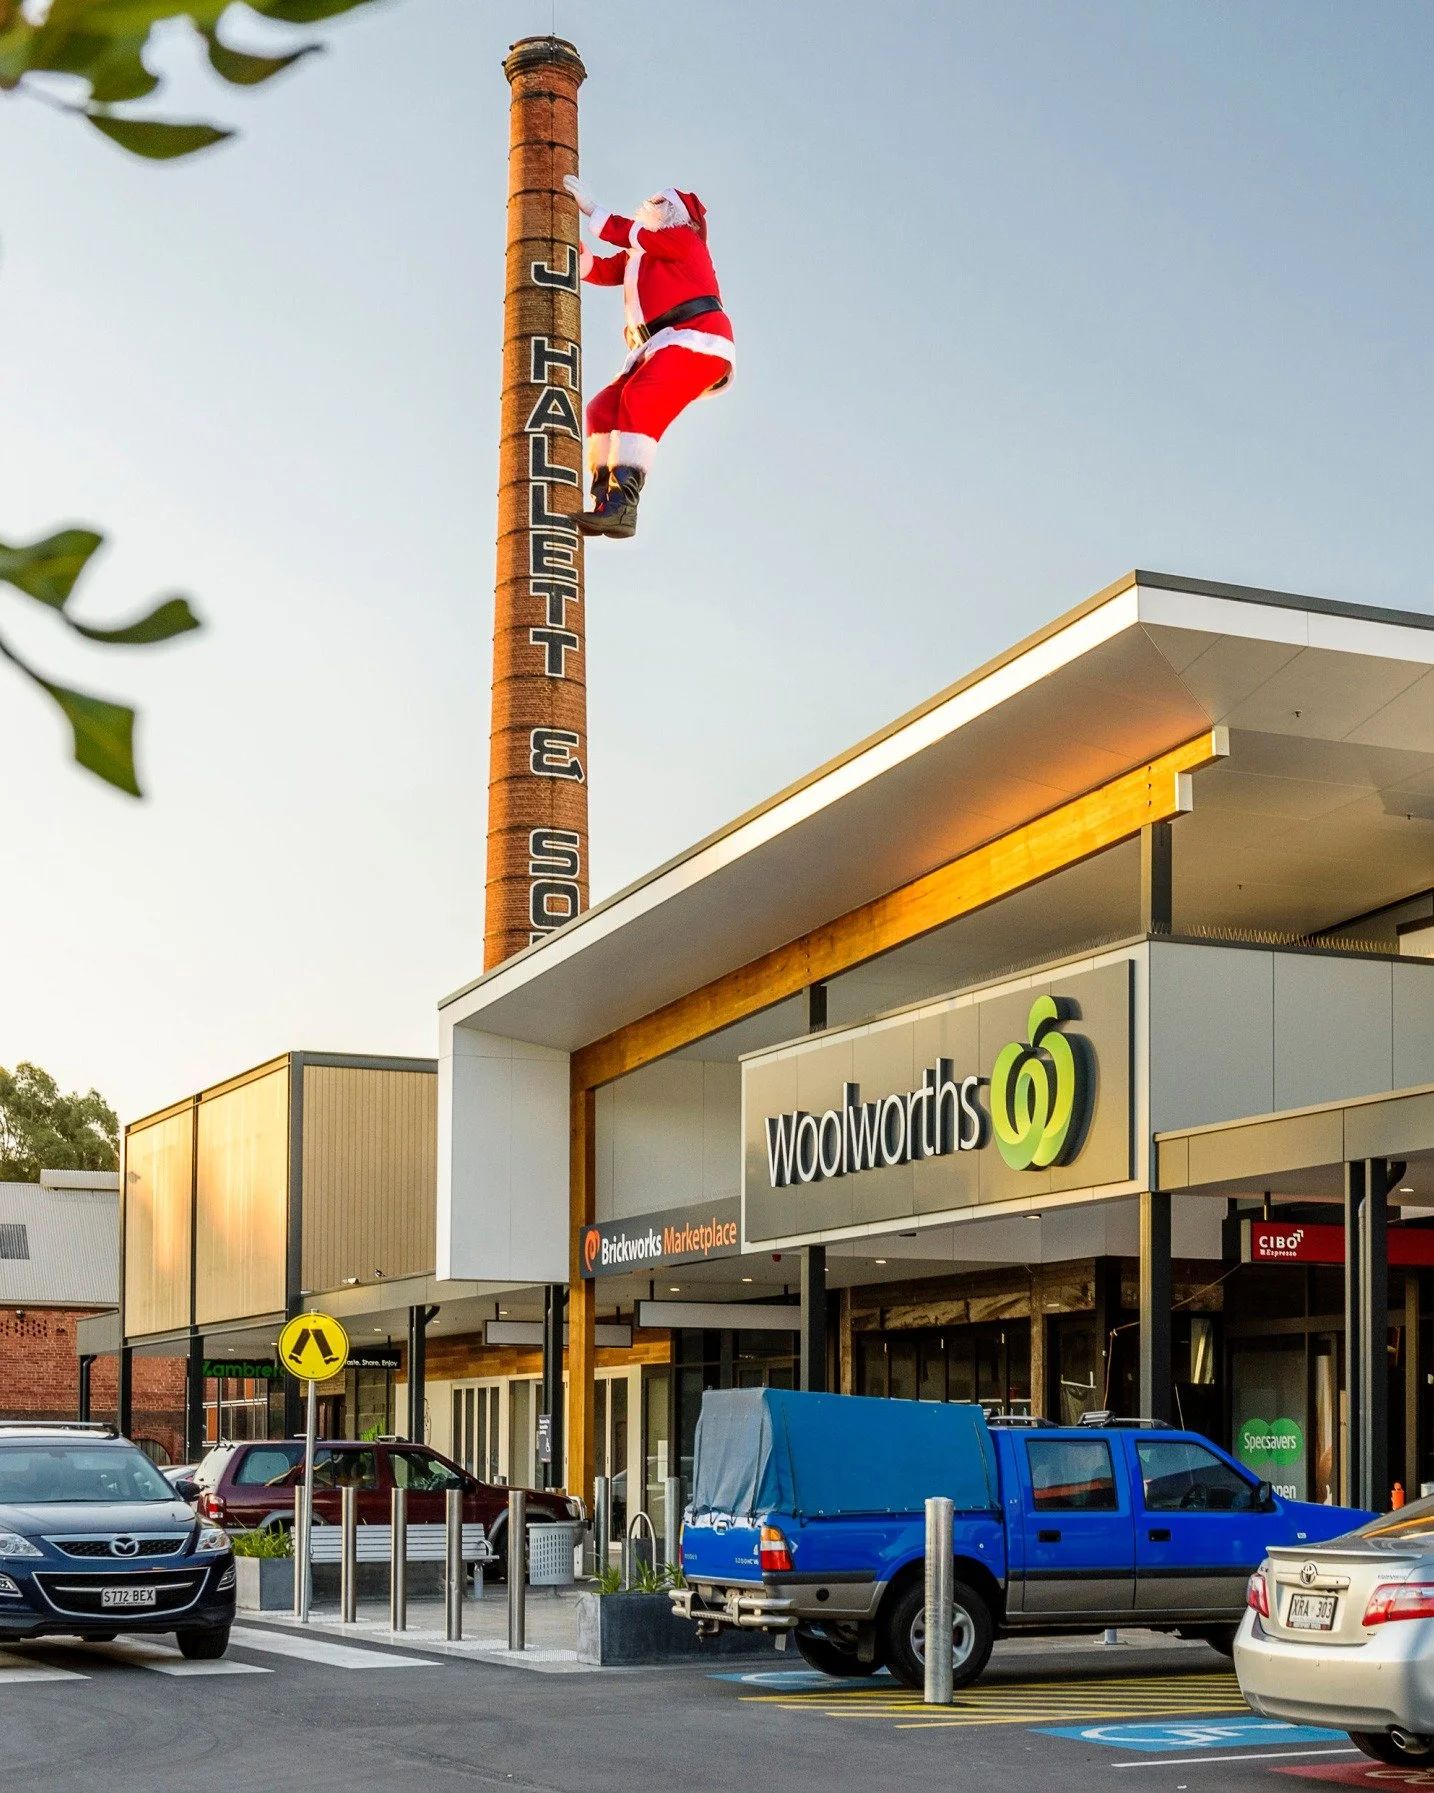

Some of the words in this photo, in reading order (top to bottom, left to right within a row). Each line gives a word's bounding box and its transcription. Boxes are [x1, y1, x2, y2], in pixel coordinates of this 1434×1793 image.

[530, 244, 578, 294] J
[524, 336, 582, 679] HALLETT
[529, 727, 585, 784] &
[764, 1057, 981, 1188] woolworths
[601, 1227, 662, 1266] Brickworks
[663, 1216, 738, 1256] Marketplace
[1258, 1235, 1298, 1250] CIBO
[1243, 1432, 1297, 1454] Specsavers
[1291, 1598, 1310, 1617] XRA
[1315, 1600, 1333, 1619] 303
